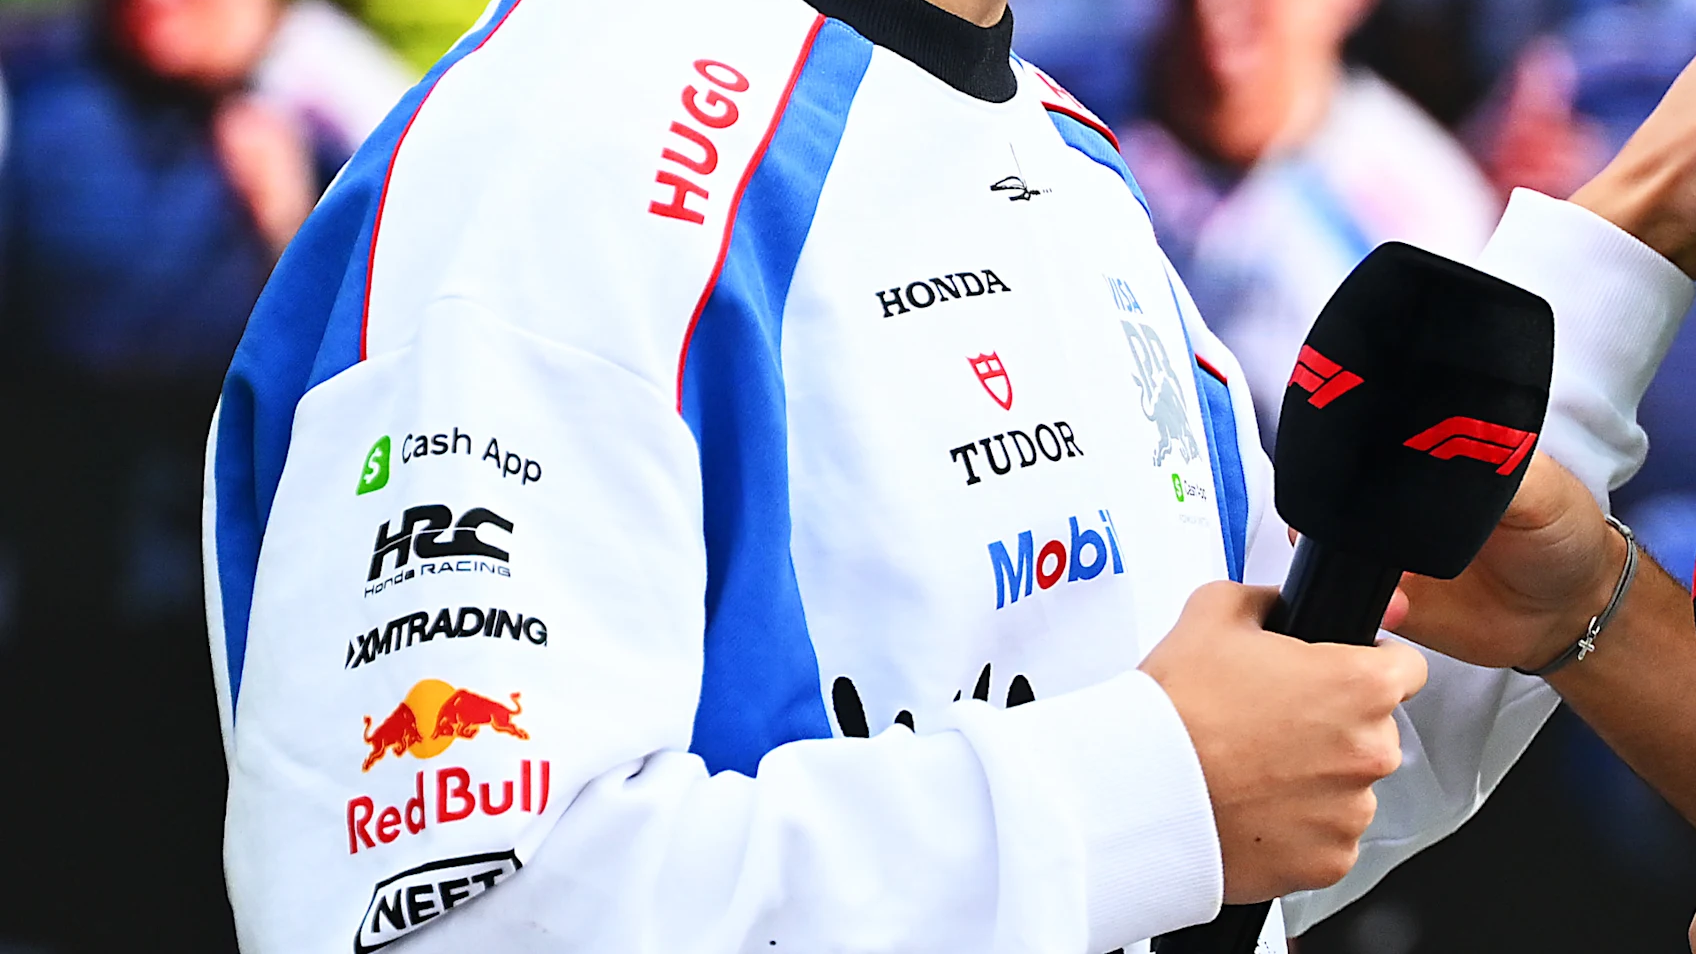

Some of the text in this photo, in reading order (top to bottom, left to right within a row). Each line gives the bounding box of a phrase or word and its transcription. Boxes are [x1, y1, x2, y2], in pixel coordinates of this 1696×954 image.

[648, 59, 749, 225] HUGO
[874, 269, 1011, 318] HONDA
[402, 427, 471, 464] Cash
[482, 437, 542, 485] App
[950, 421, 1084, 486] TUDOR
[1403, 416, 1537, 475] F1
[367, 504, 514, 582] HRC
[987, 509, 1128, 611] Mobi
[364, 561, 511, 598] Honda RACING
[345, 607, 547, 670] XMTRADING
[347, 759, 550, 855] Red Bull
